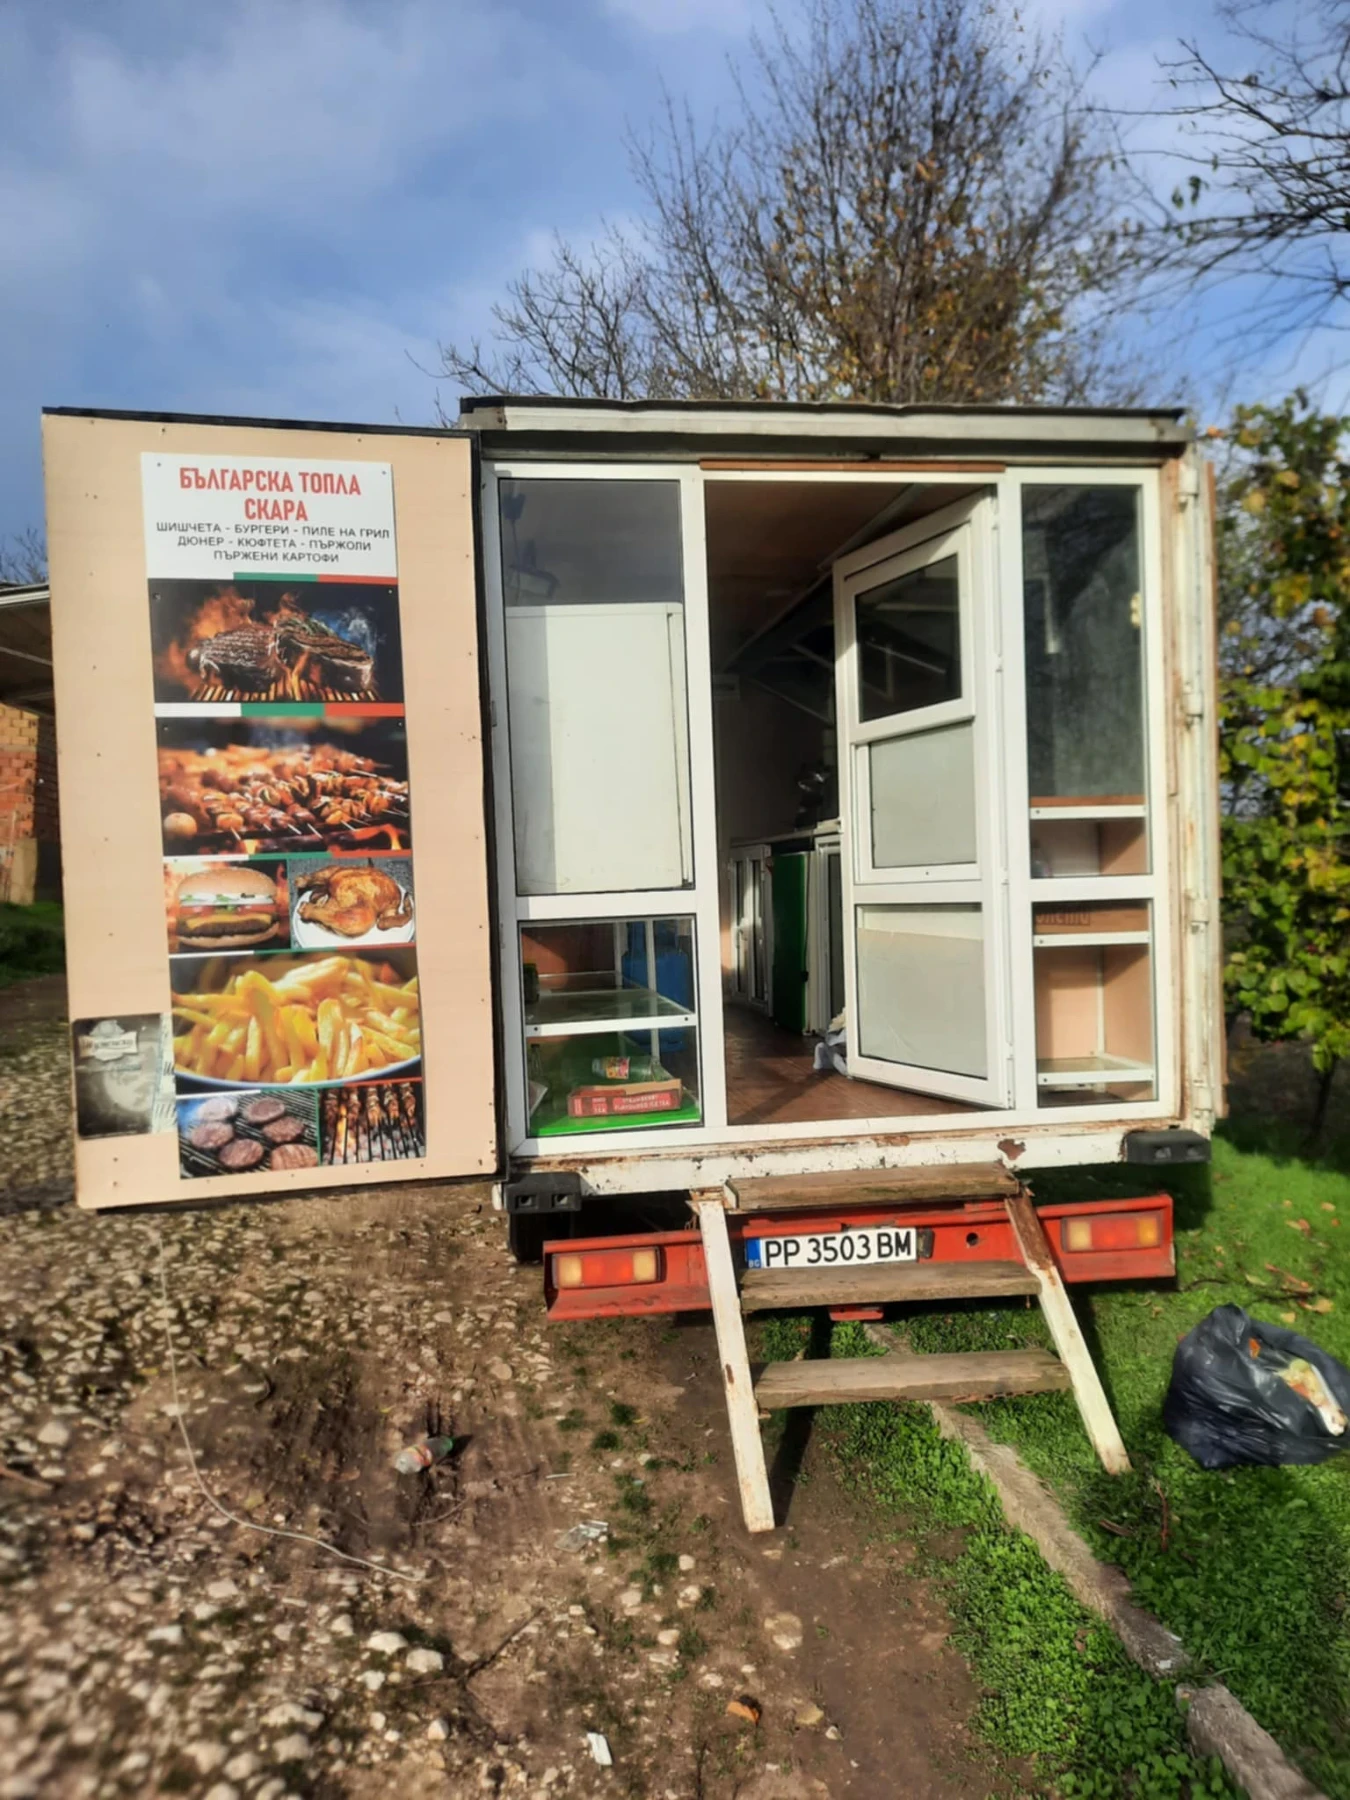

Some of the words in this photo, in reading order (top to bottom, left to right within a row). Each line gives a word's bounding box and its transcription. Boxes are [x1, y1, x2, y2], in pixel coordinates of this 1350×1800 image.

[179, 467, 293, 493] БЪЛГАРСКА
[299, 472, 361, 495] ТОПЛА
[245, 498, 308, 521] СКАРА
[156, 522, 221, 533] ШИШЧЕТА
[234, 524, 289, 535] БУРГЕРИ
[302, 526, 335, 537] ПИЛЕ
[339, 527, 356, 538] НА
[359, 528, 390, 539] ГРИЛ
[177, 536, 224, 547] ДЮНЕР
[237, 537, 297, 549] КЮФТЕТА
[309, 540, 371, 551] ПЪРЖОЛИ
[214, 550, 278, 561] ПЪРЖЕНИ
[282, 551, 339, 563] КАРТОФИ
[765, 1239, 800, 1267] PP
[807, 1234, 871, 1264] 3503
[877, 1231, 911, 1258] BM
